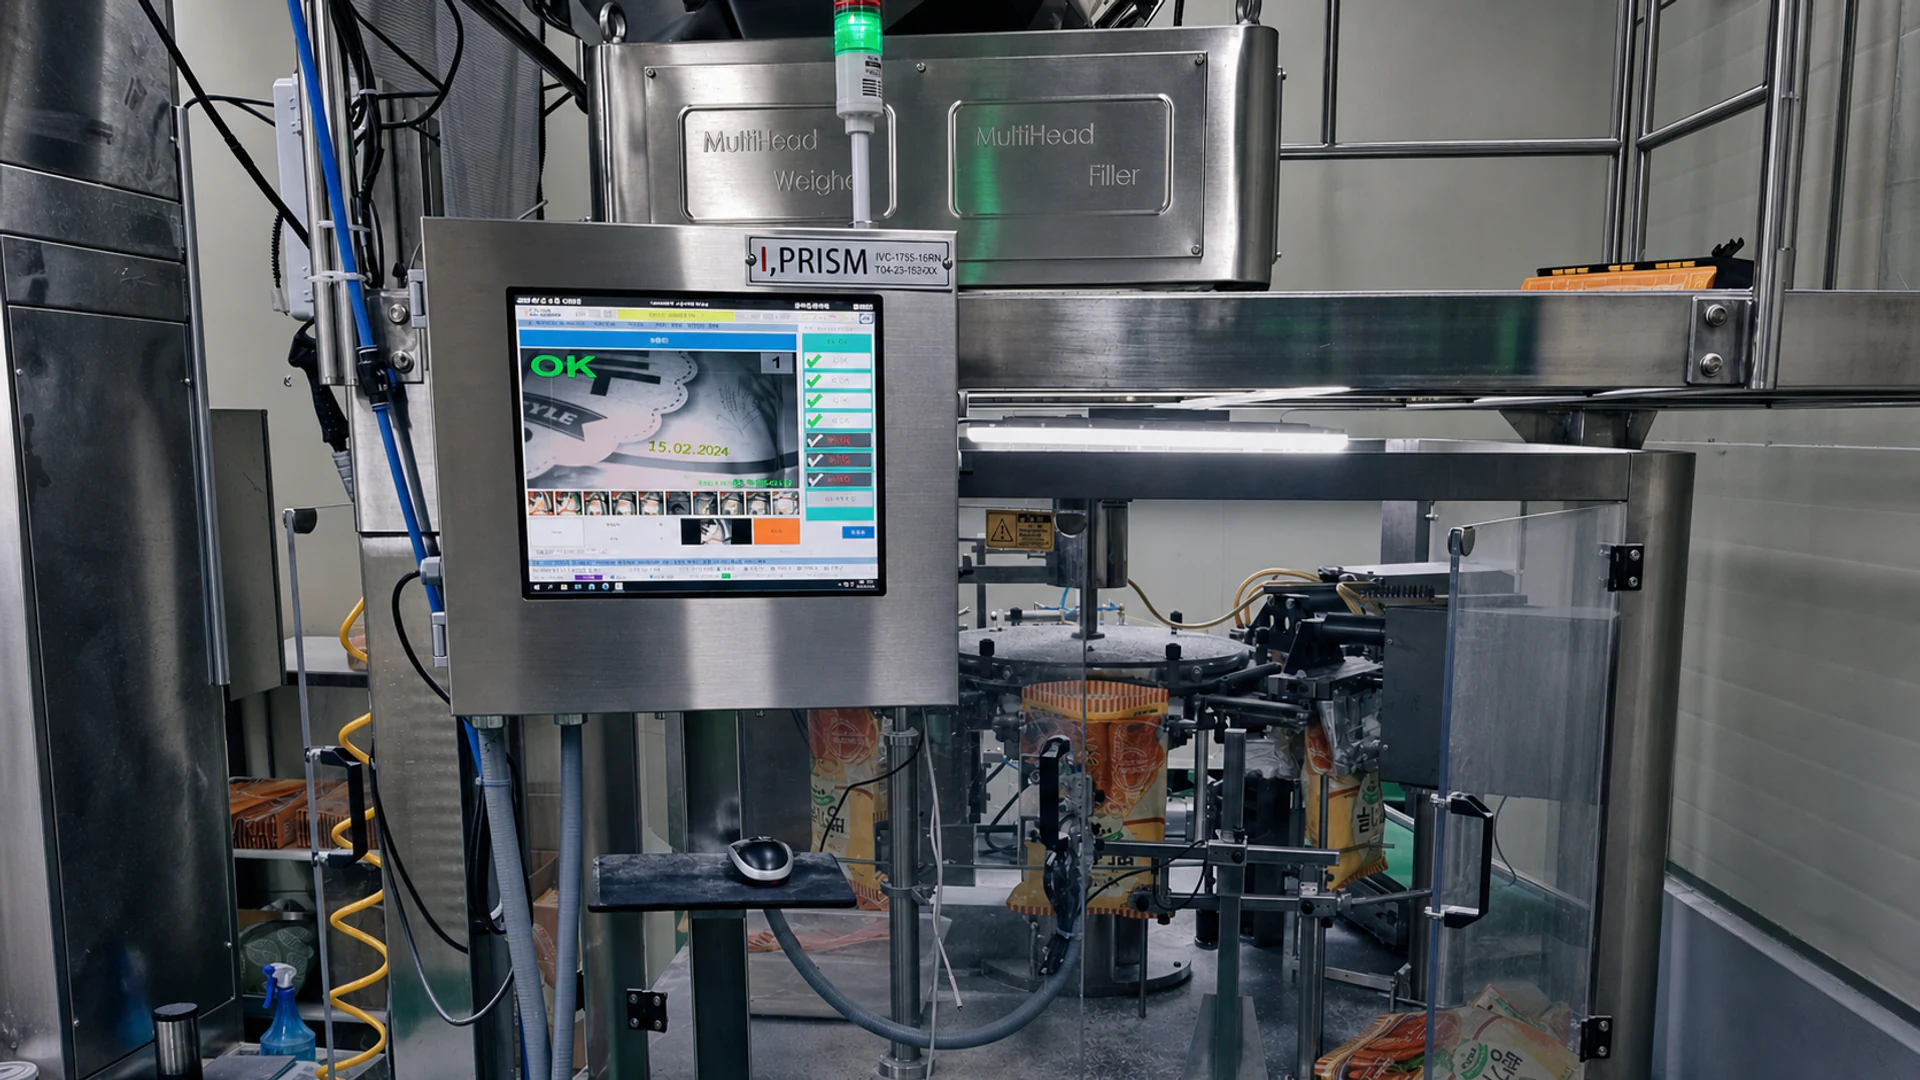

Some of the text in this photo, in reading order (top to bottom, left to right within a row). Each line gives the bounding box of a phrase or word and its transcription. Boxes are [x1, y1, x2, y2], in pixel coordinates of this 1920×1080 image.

[703, 129, 817, 153] MultiHead
[976, 123, 1095, 147] MultiHead
[1090, 164, 1140, 187] Filler
[530, 354, 597, 379] OK
[772, 356, 780, 369] 1
[523, 401, 578, 425] YLE
[648, 440, 729, 457] 15.02.2024
